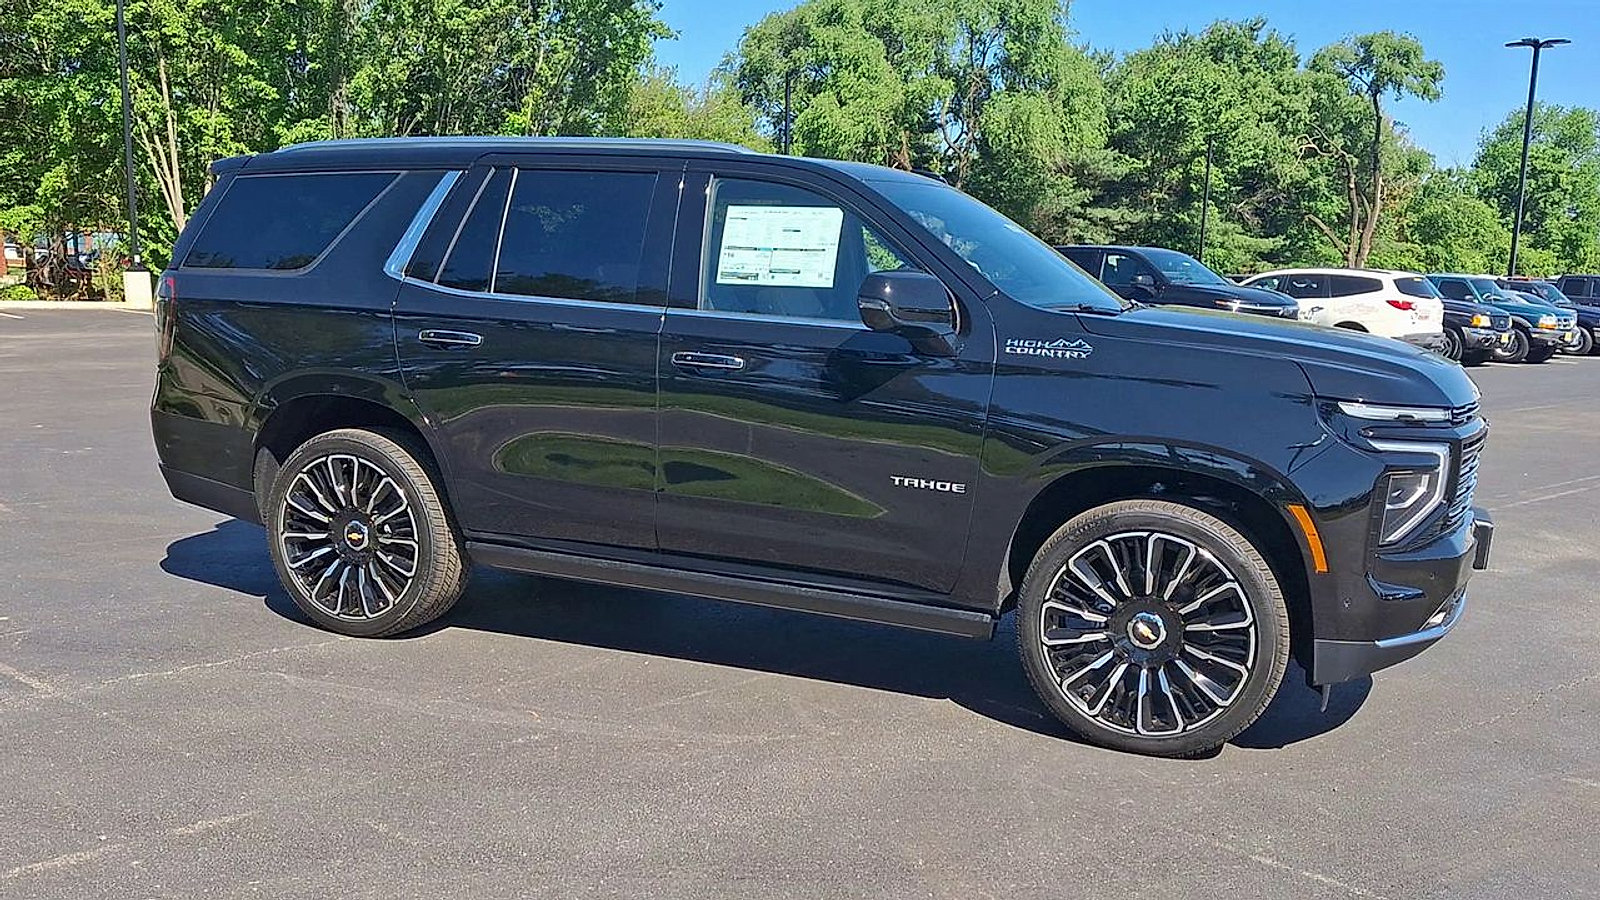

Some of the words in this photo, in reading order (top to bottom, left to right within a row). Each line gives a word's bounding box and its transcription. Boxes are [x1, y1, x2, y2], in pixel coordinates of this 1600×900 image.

[1006, 339, 1050, 348] HIGH
[1005, 347, 1092, 359] COUNTRY
[890, 476, 966, 493] TAHOE
